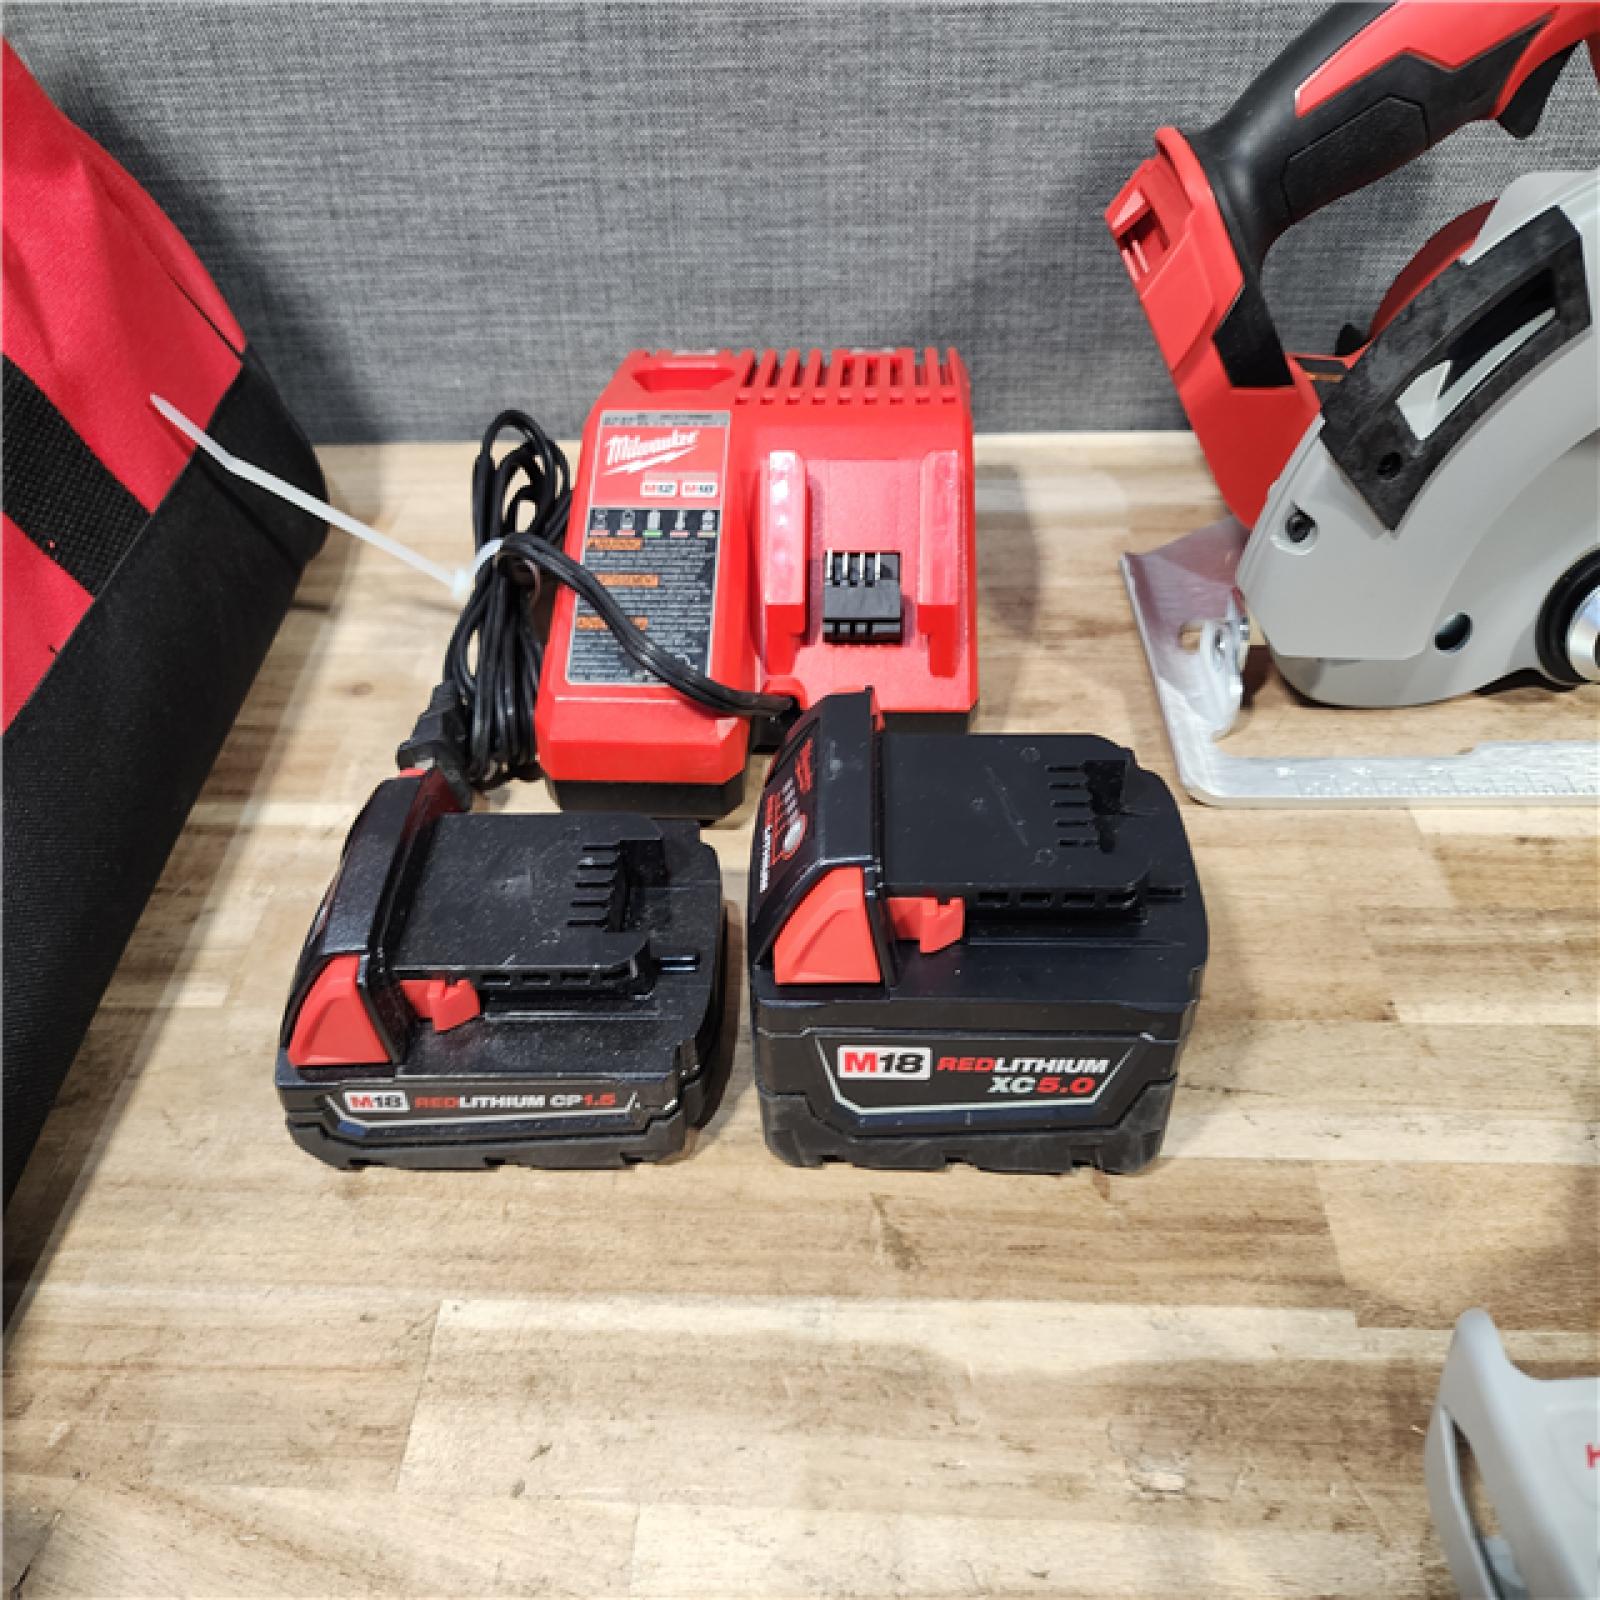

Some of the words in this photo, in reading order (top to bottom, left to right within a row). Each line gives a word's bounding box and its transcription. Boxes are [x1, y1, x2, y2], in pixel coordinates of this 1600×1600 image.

[604, 430, 699, 466] Milwaukee
[845, 1052, 925, 1073] M18
[937, 1057, 1109, 1073] REDLITHIUM
[350, 1096, 403, 1109] M18
[415, 1094, 546, 1109] REDLITHIUM
